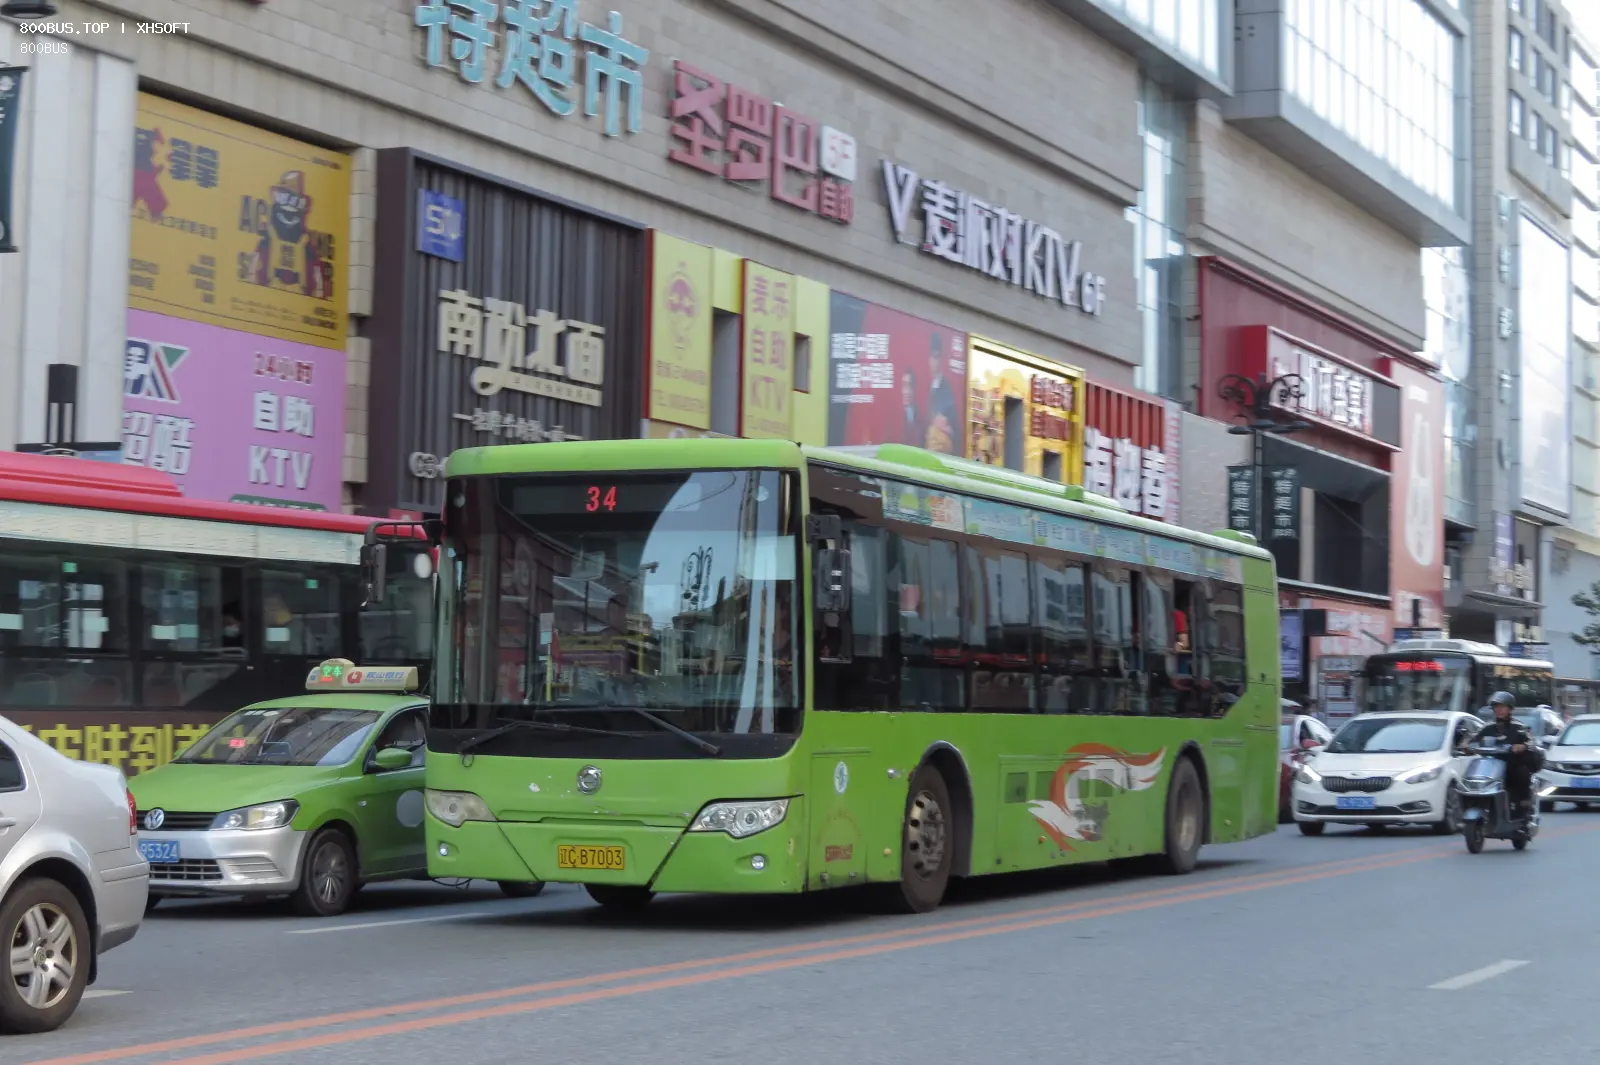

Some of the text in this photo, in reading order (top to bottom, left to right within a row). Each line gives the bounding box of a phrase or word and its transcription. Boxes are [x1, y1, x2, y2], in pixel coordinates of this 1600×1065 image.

[253, 390, 315, 438] 自助
[248, 444, 313, 490] KTV
[586, 486, 617, 512] 34
